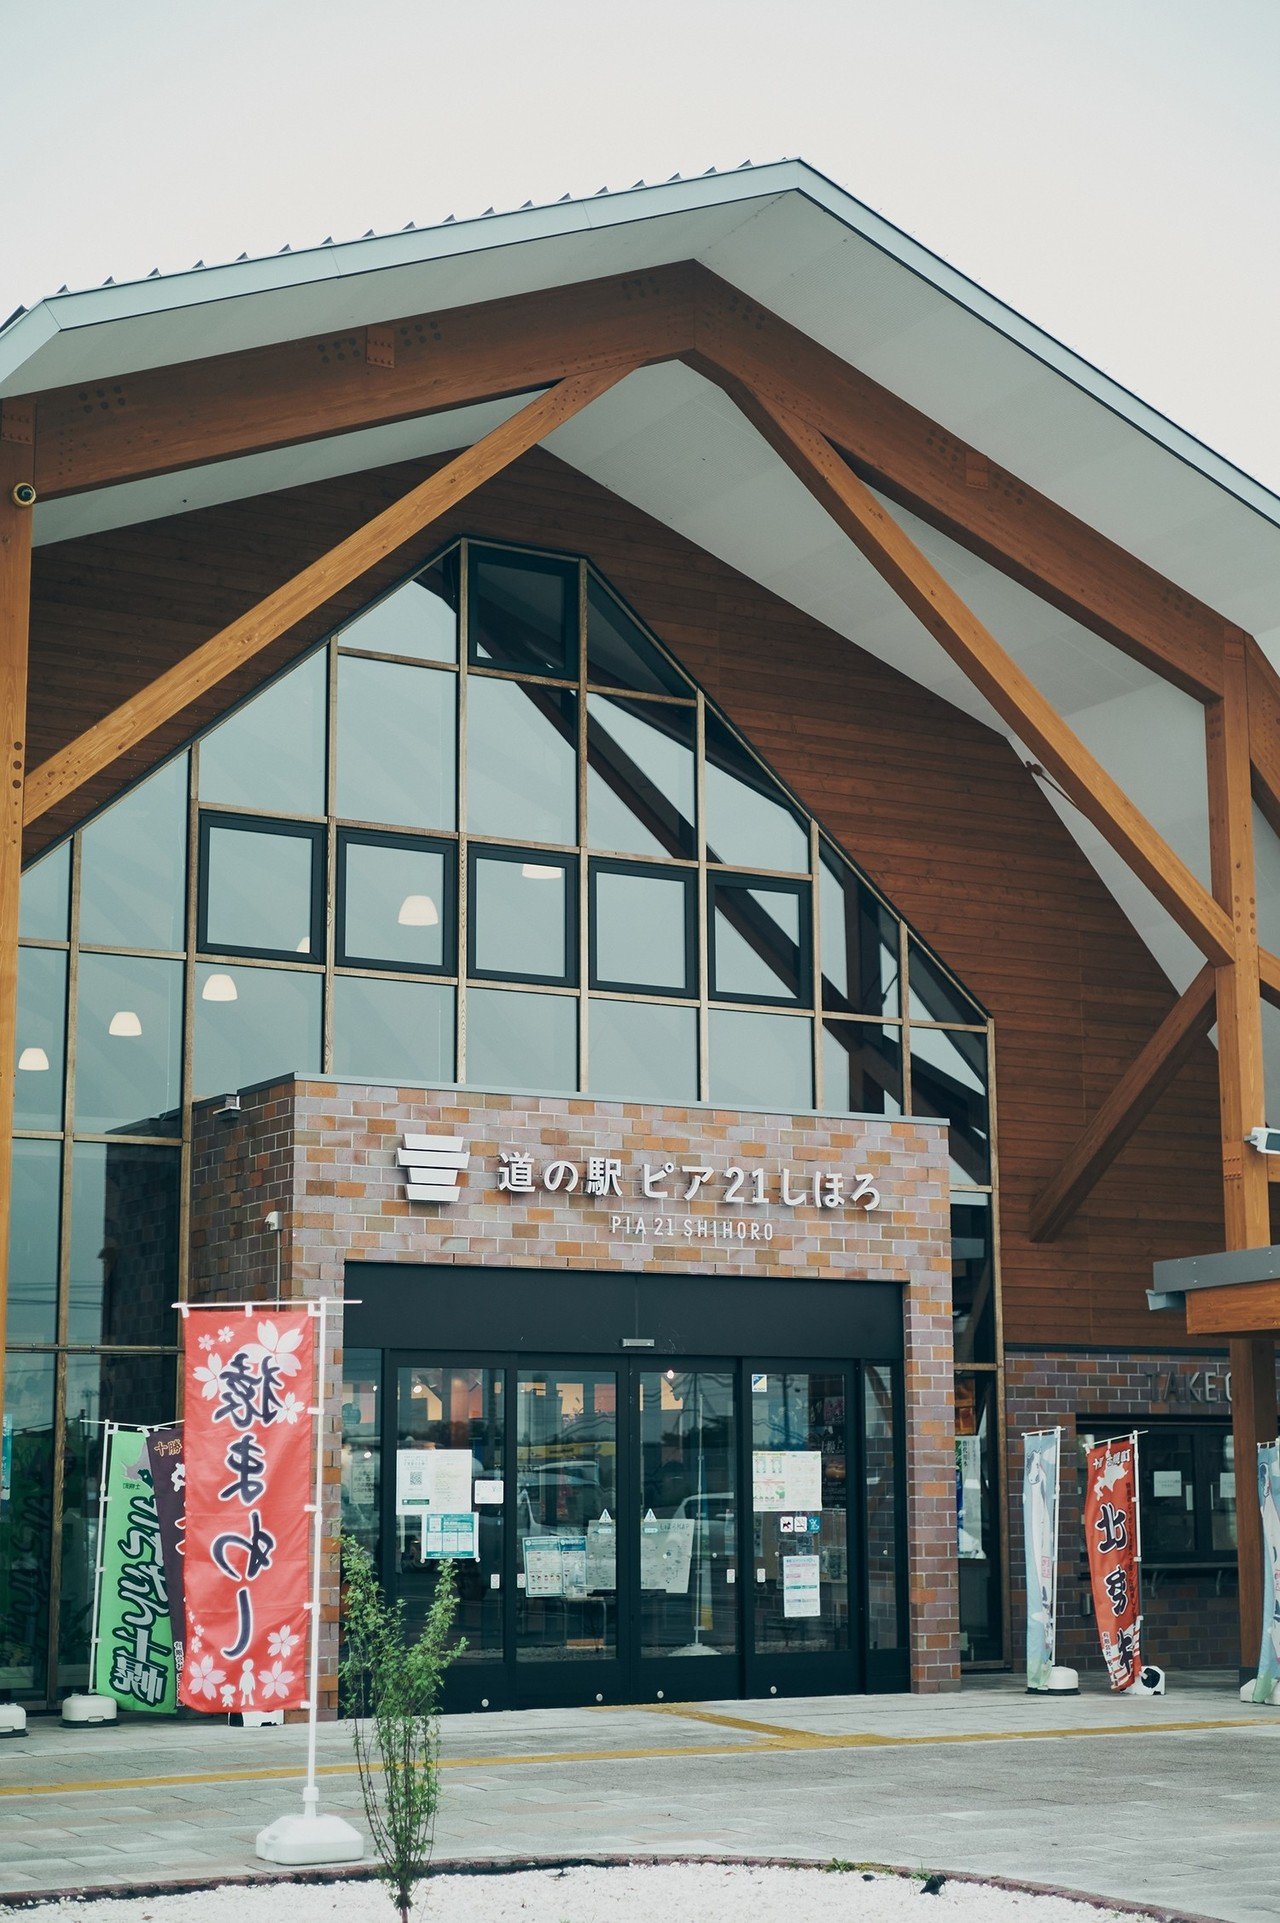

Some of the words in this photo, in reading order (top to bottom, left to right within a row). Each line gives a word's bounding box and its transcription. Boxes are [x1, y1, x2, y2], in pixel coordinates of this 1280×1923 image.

[498, 1151, 623, 1196] 道の駅
[611, 1215, 647, 1236] PIA
[653, 1217, 675, 1237] 21
[683, 1219, 774, 1242] SHIHORO
